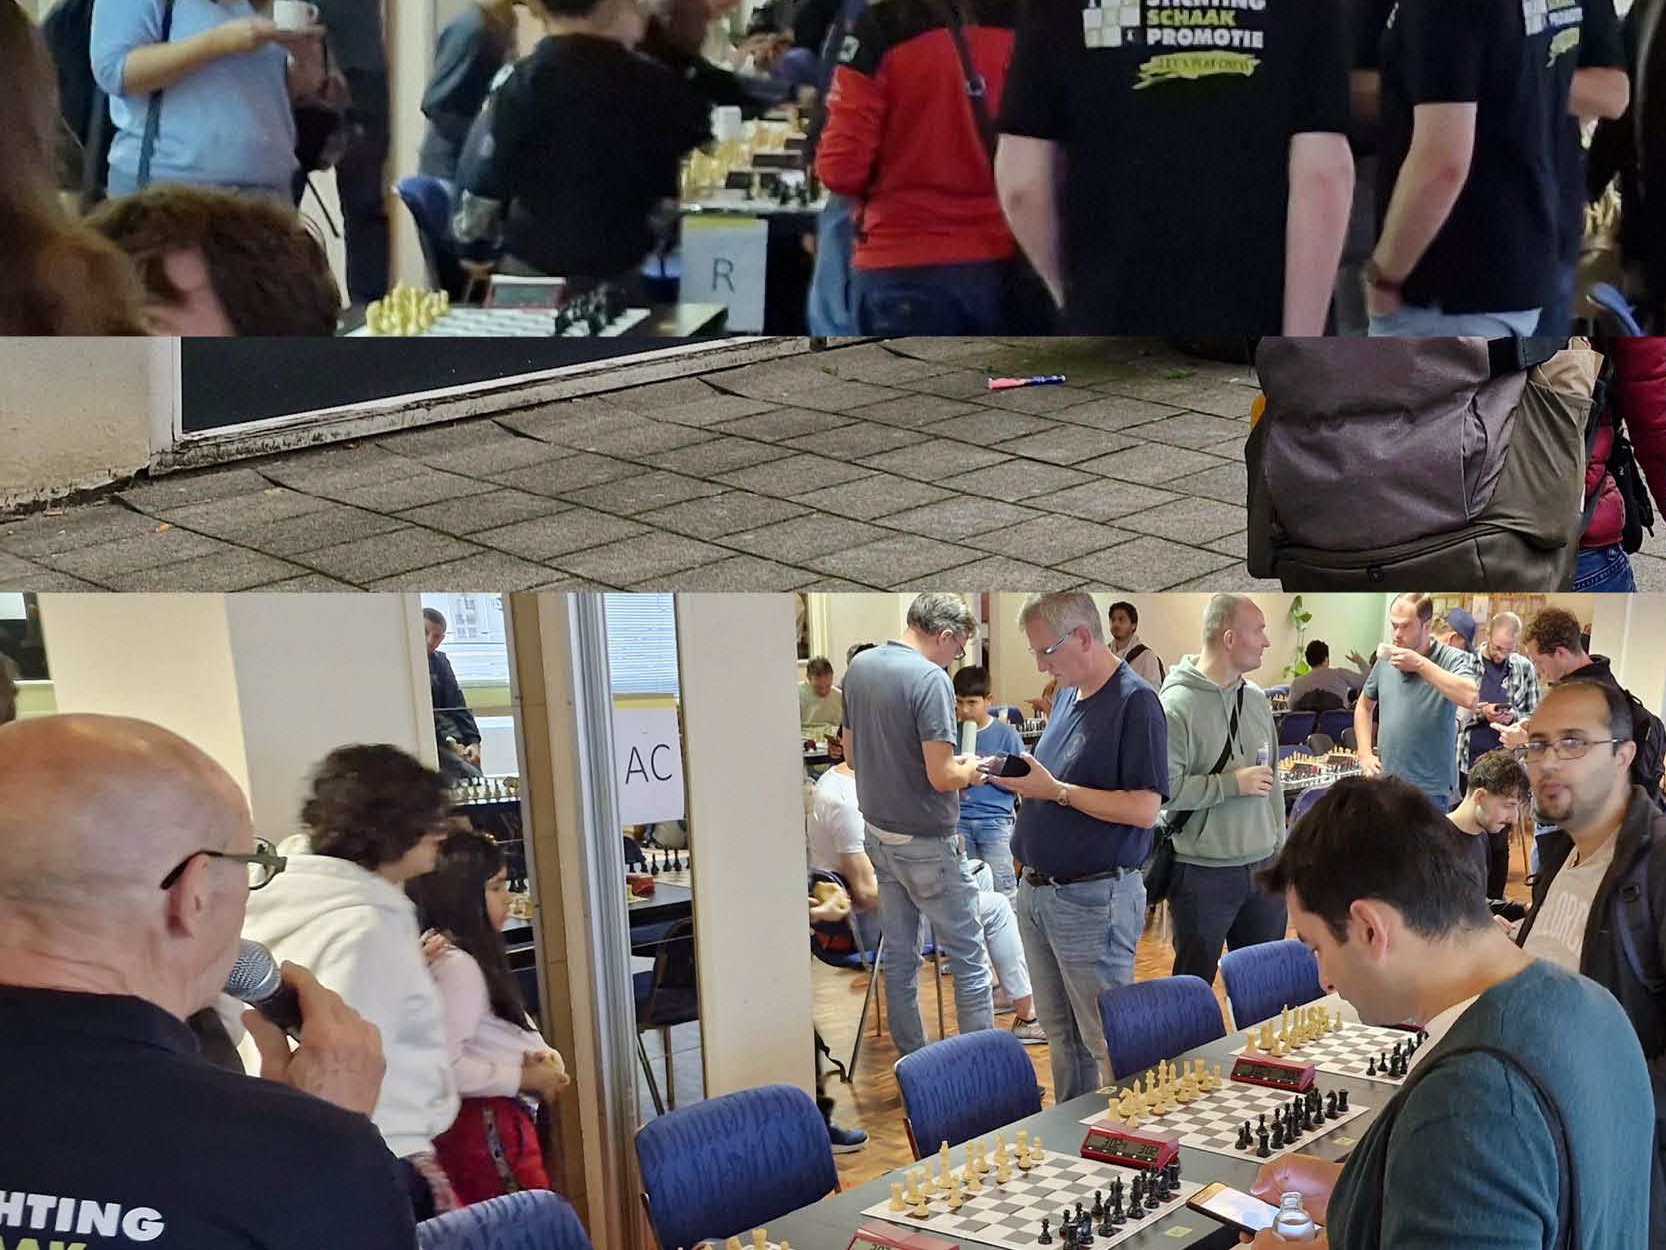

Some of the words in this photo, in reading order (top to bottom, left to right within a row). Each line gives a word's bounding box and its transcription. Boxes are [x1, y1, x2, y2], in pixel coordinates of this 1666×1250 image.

[1146, 8, 1237, 27] SCHAAK
[1146, 27, 1264, 49] PROMOTIE
[713, 257, 735, 292] R
[625, 743, 674, 785] AC
